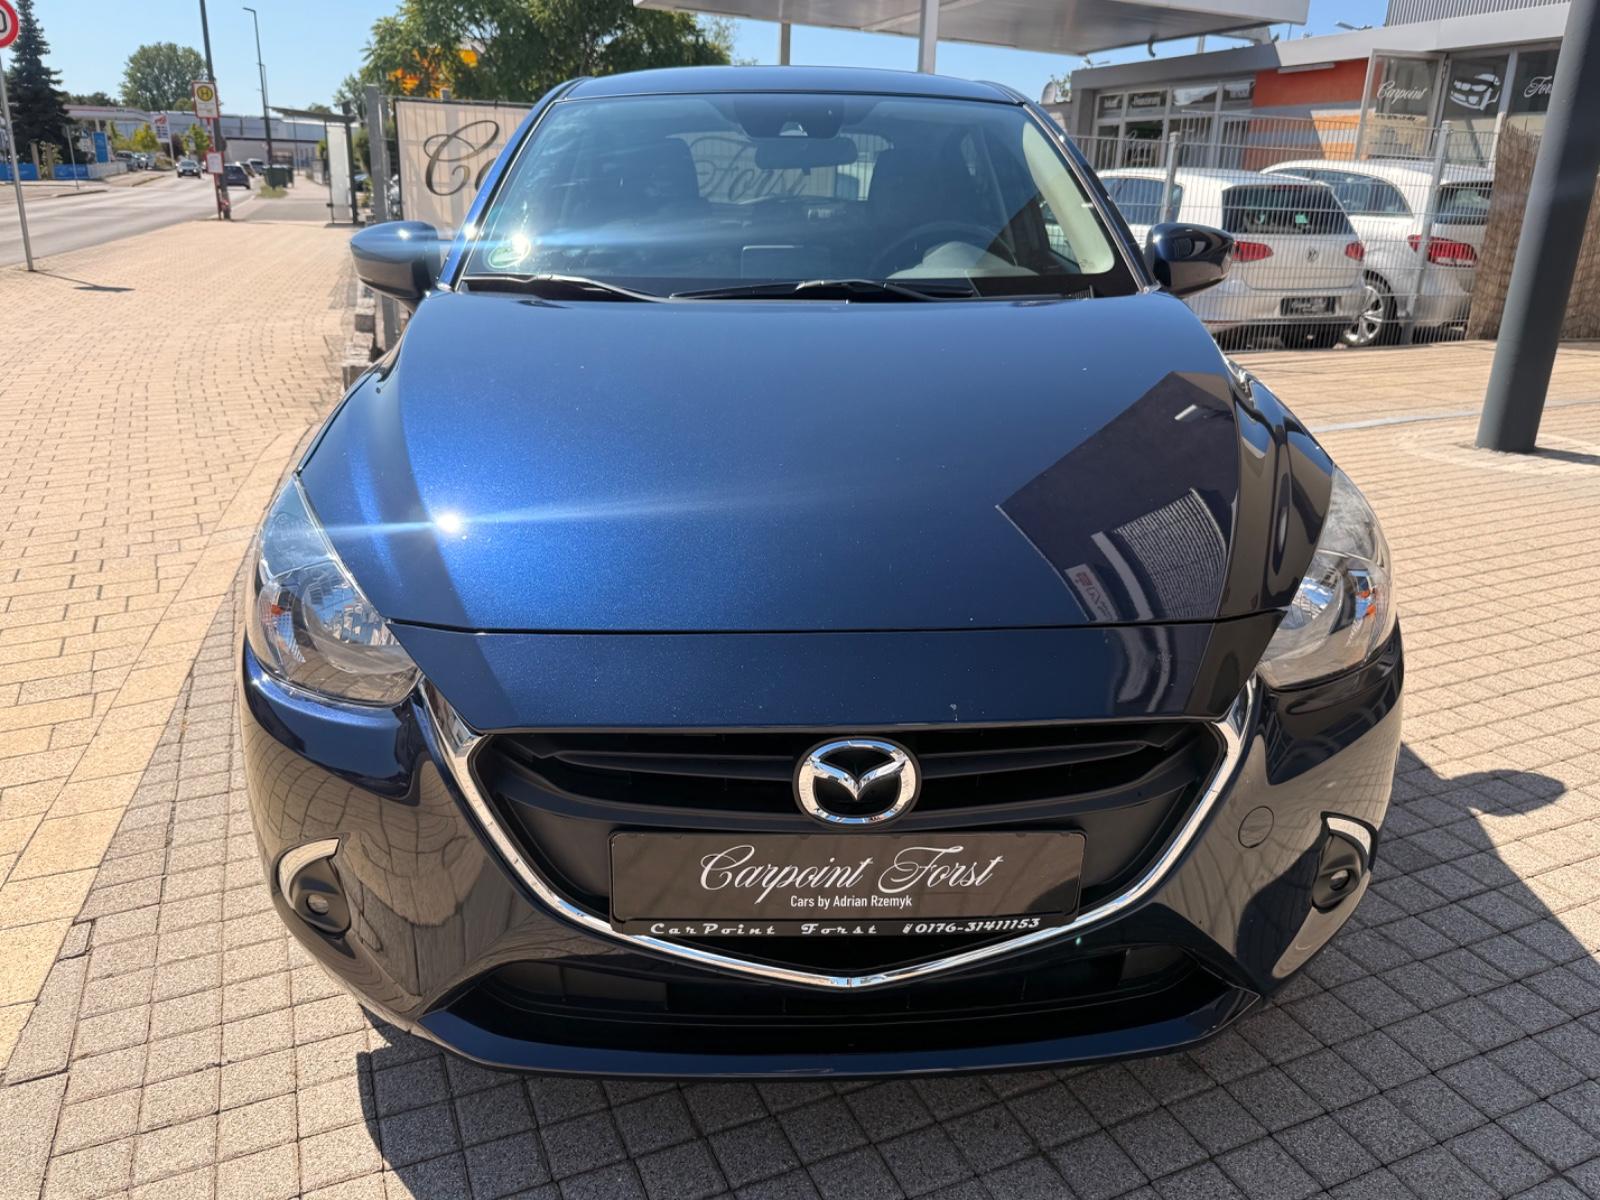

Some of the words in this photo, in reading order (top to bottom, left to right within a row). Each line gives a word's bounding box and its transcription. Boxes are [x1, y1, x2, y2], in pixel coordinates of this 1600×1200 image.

[1376, 79, 1428, 105] Carpoint
[700, 844, 873, 905] Carpoint
[877, 845, 1004, 894] Forst
[790, 895, 815, 907] Cars
[817, 895, 831, 910] by
[833, 895, 868, 907] Adrian
[870, 894, 912, 909] Rzemyk
[650, 922, 776, 935] CarPoint
[801, 922, 877, 935] Forst
